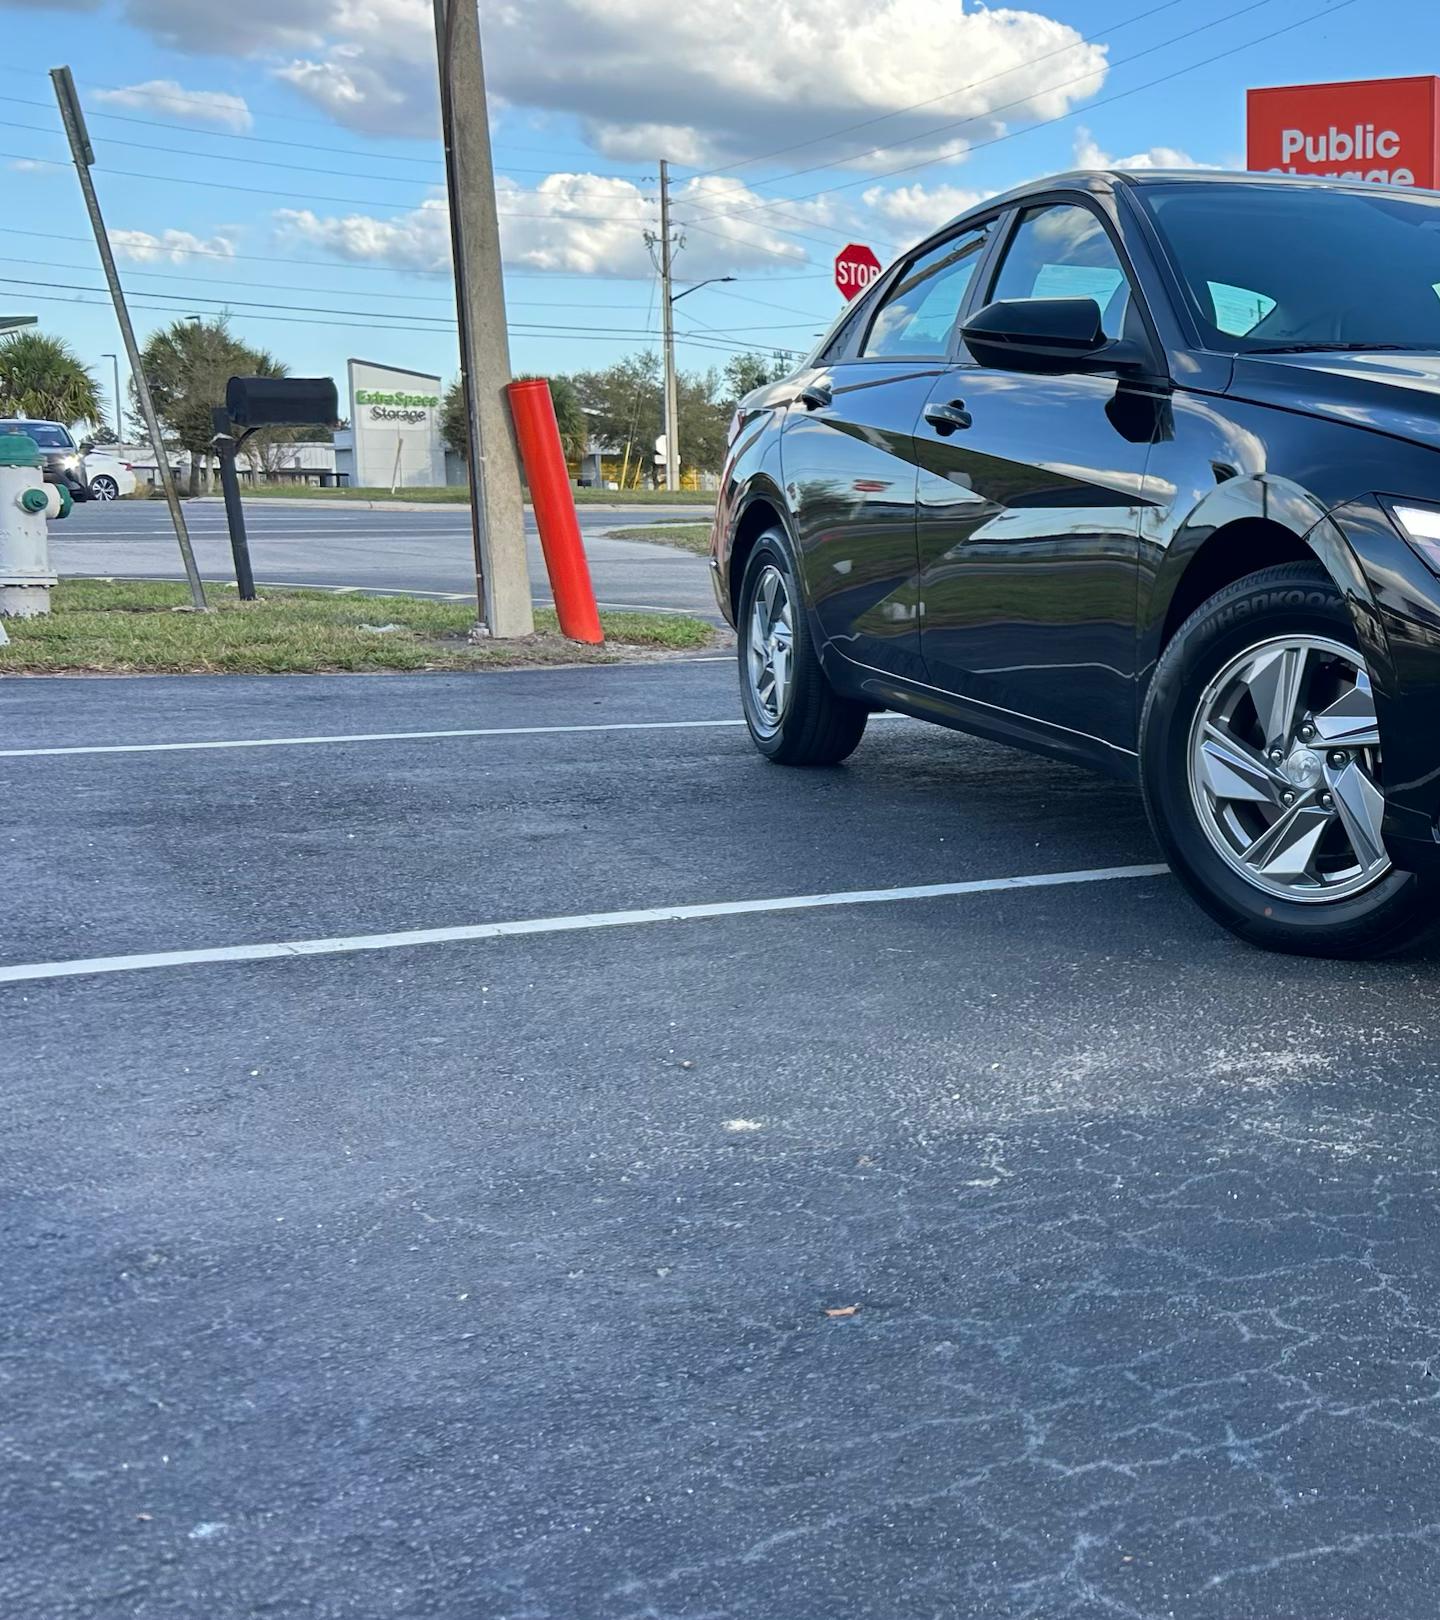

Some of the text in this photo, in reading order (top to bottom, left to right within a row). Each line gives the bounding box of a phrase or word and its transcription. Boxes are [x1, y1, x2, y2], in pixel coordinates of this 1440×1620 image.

[1281, 124, 1401, 164] Public
[837, 260, 880, 288] STOP
[370, 406, 427, 423] Storage
